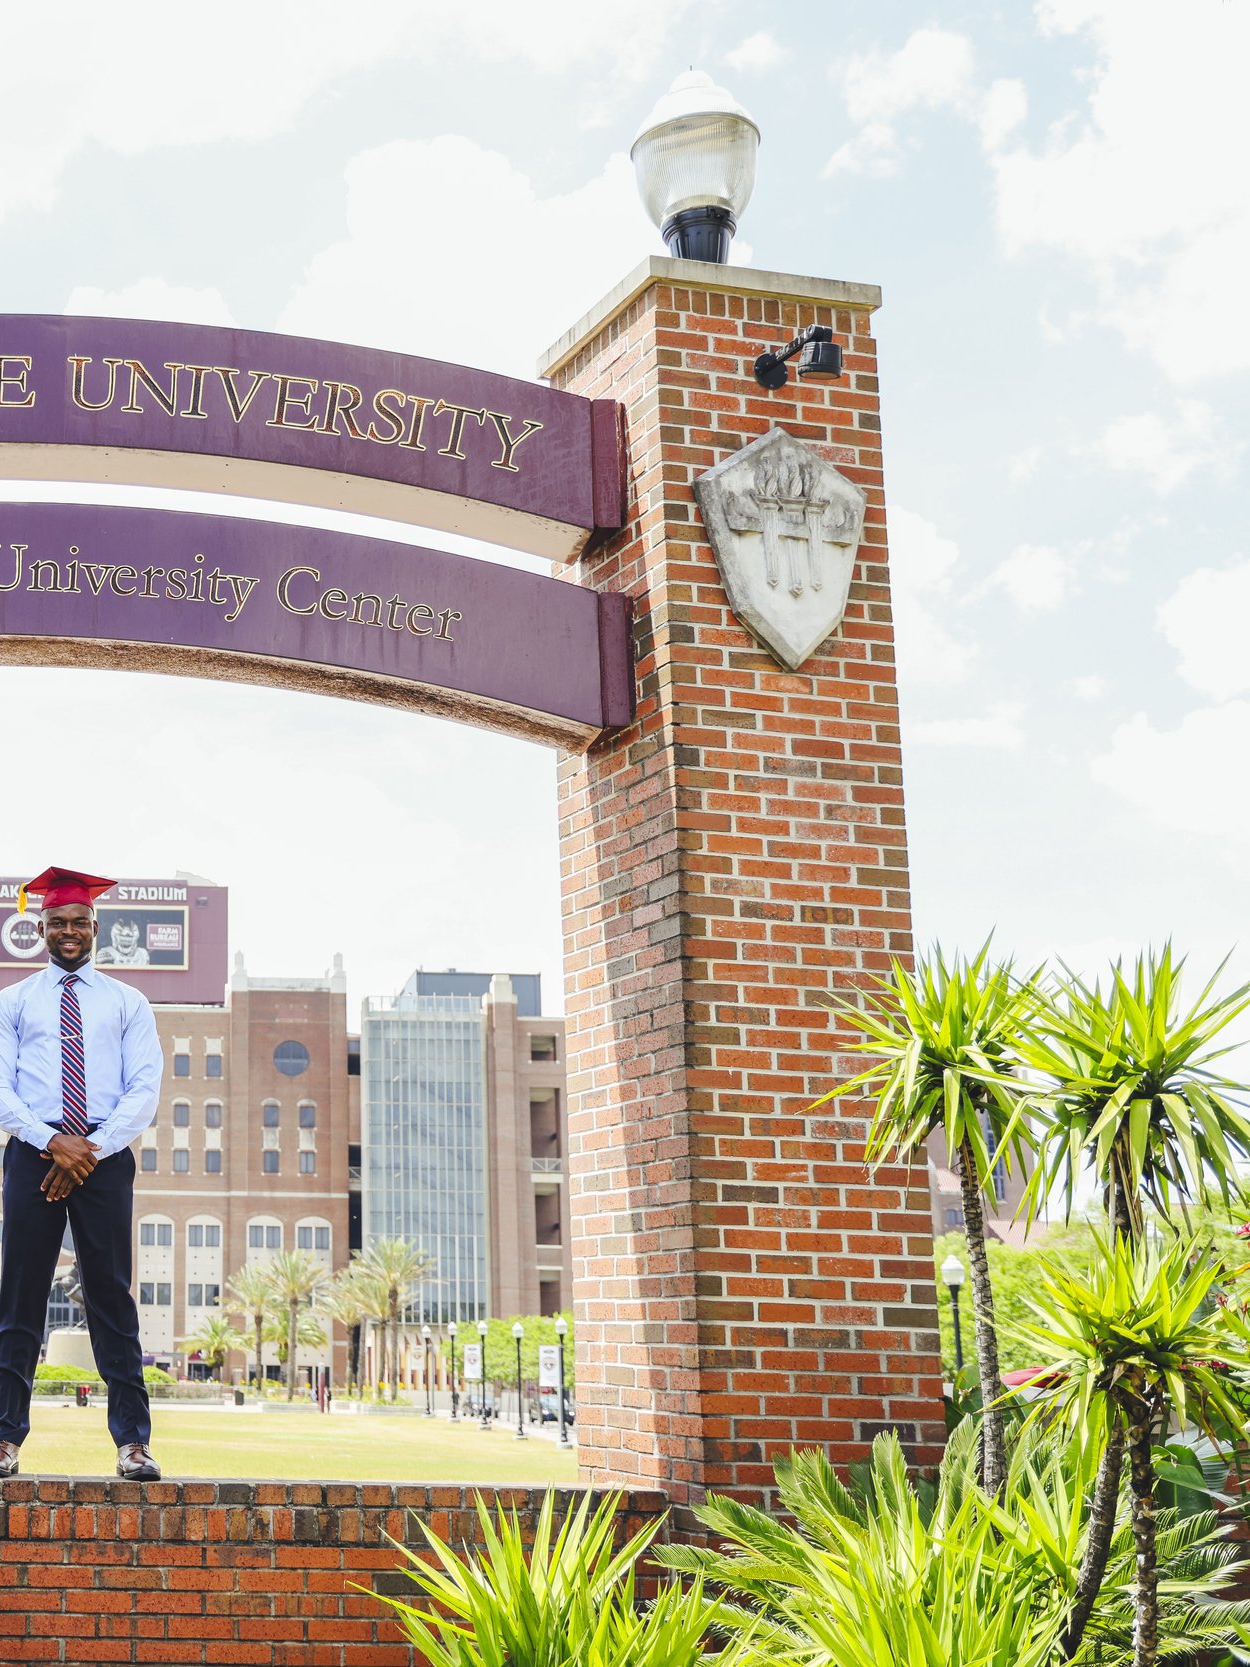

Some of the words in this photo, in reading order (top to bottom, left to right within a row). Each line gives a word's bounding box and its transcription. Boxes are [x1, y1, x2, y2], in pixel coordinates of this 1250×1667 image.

[67, 353, 543, 473] UNIVERSITY
[276, 566, 463, 643] Center
[118, 886, 187, 901] STADIUM
